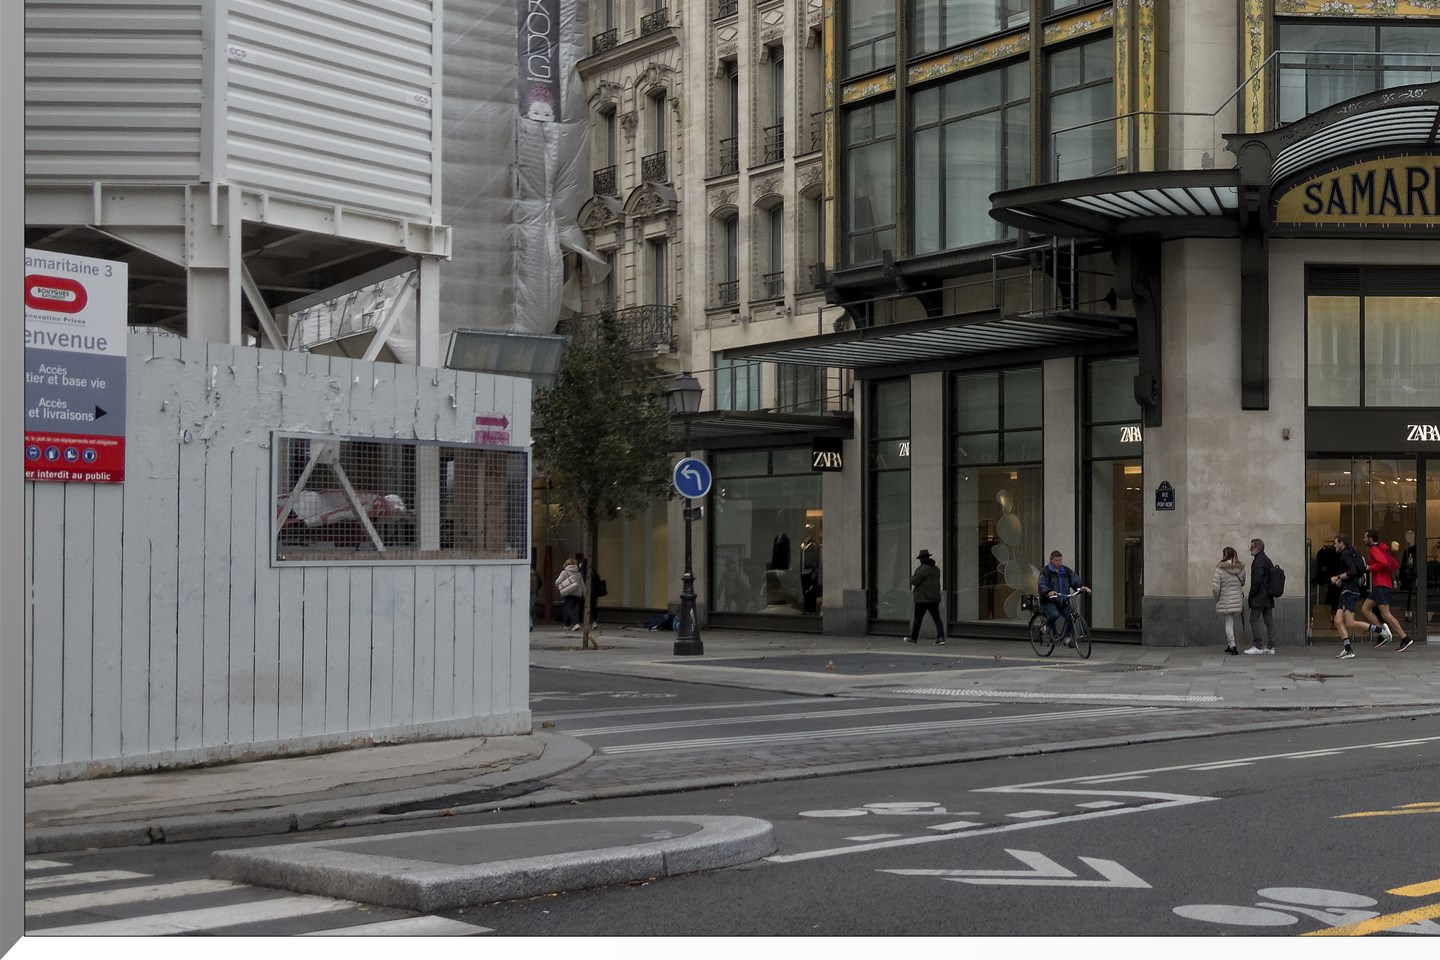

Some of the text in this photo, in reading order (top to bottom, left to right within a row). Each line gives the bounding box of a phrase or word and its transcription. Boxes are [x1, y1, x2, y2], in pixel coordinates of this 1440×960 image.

[25, 256, 113, 277] amaritaine 3
[37, 287, 70, 297] BOUYGUES
[63, 316, 86, 325] Privée
[25, 328, 108, 351] envenue
[39, 363, 67, 375] Accès
[26, 372, 106, 389] tier et base vie
[39, 397, 67, 408] Accès
[28, 407, 94, 421] et livraisons
[1120, 426, 1142, 443] ZARA
[813, 451, 842, 467] ZARA
[25, 470, 35, 478] er
[37, 469, 69, 479] interdit
[85, 471, 111, 481] public
